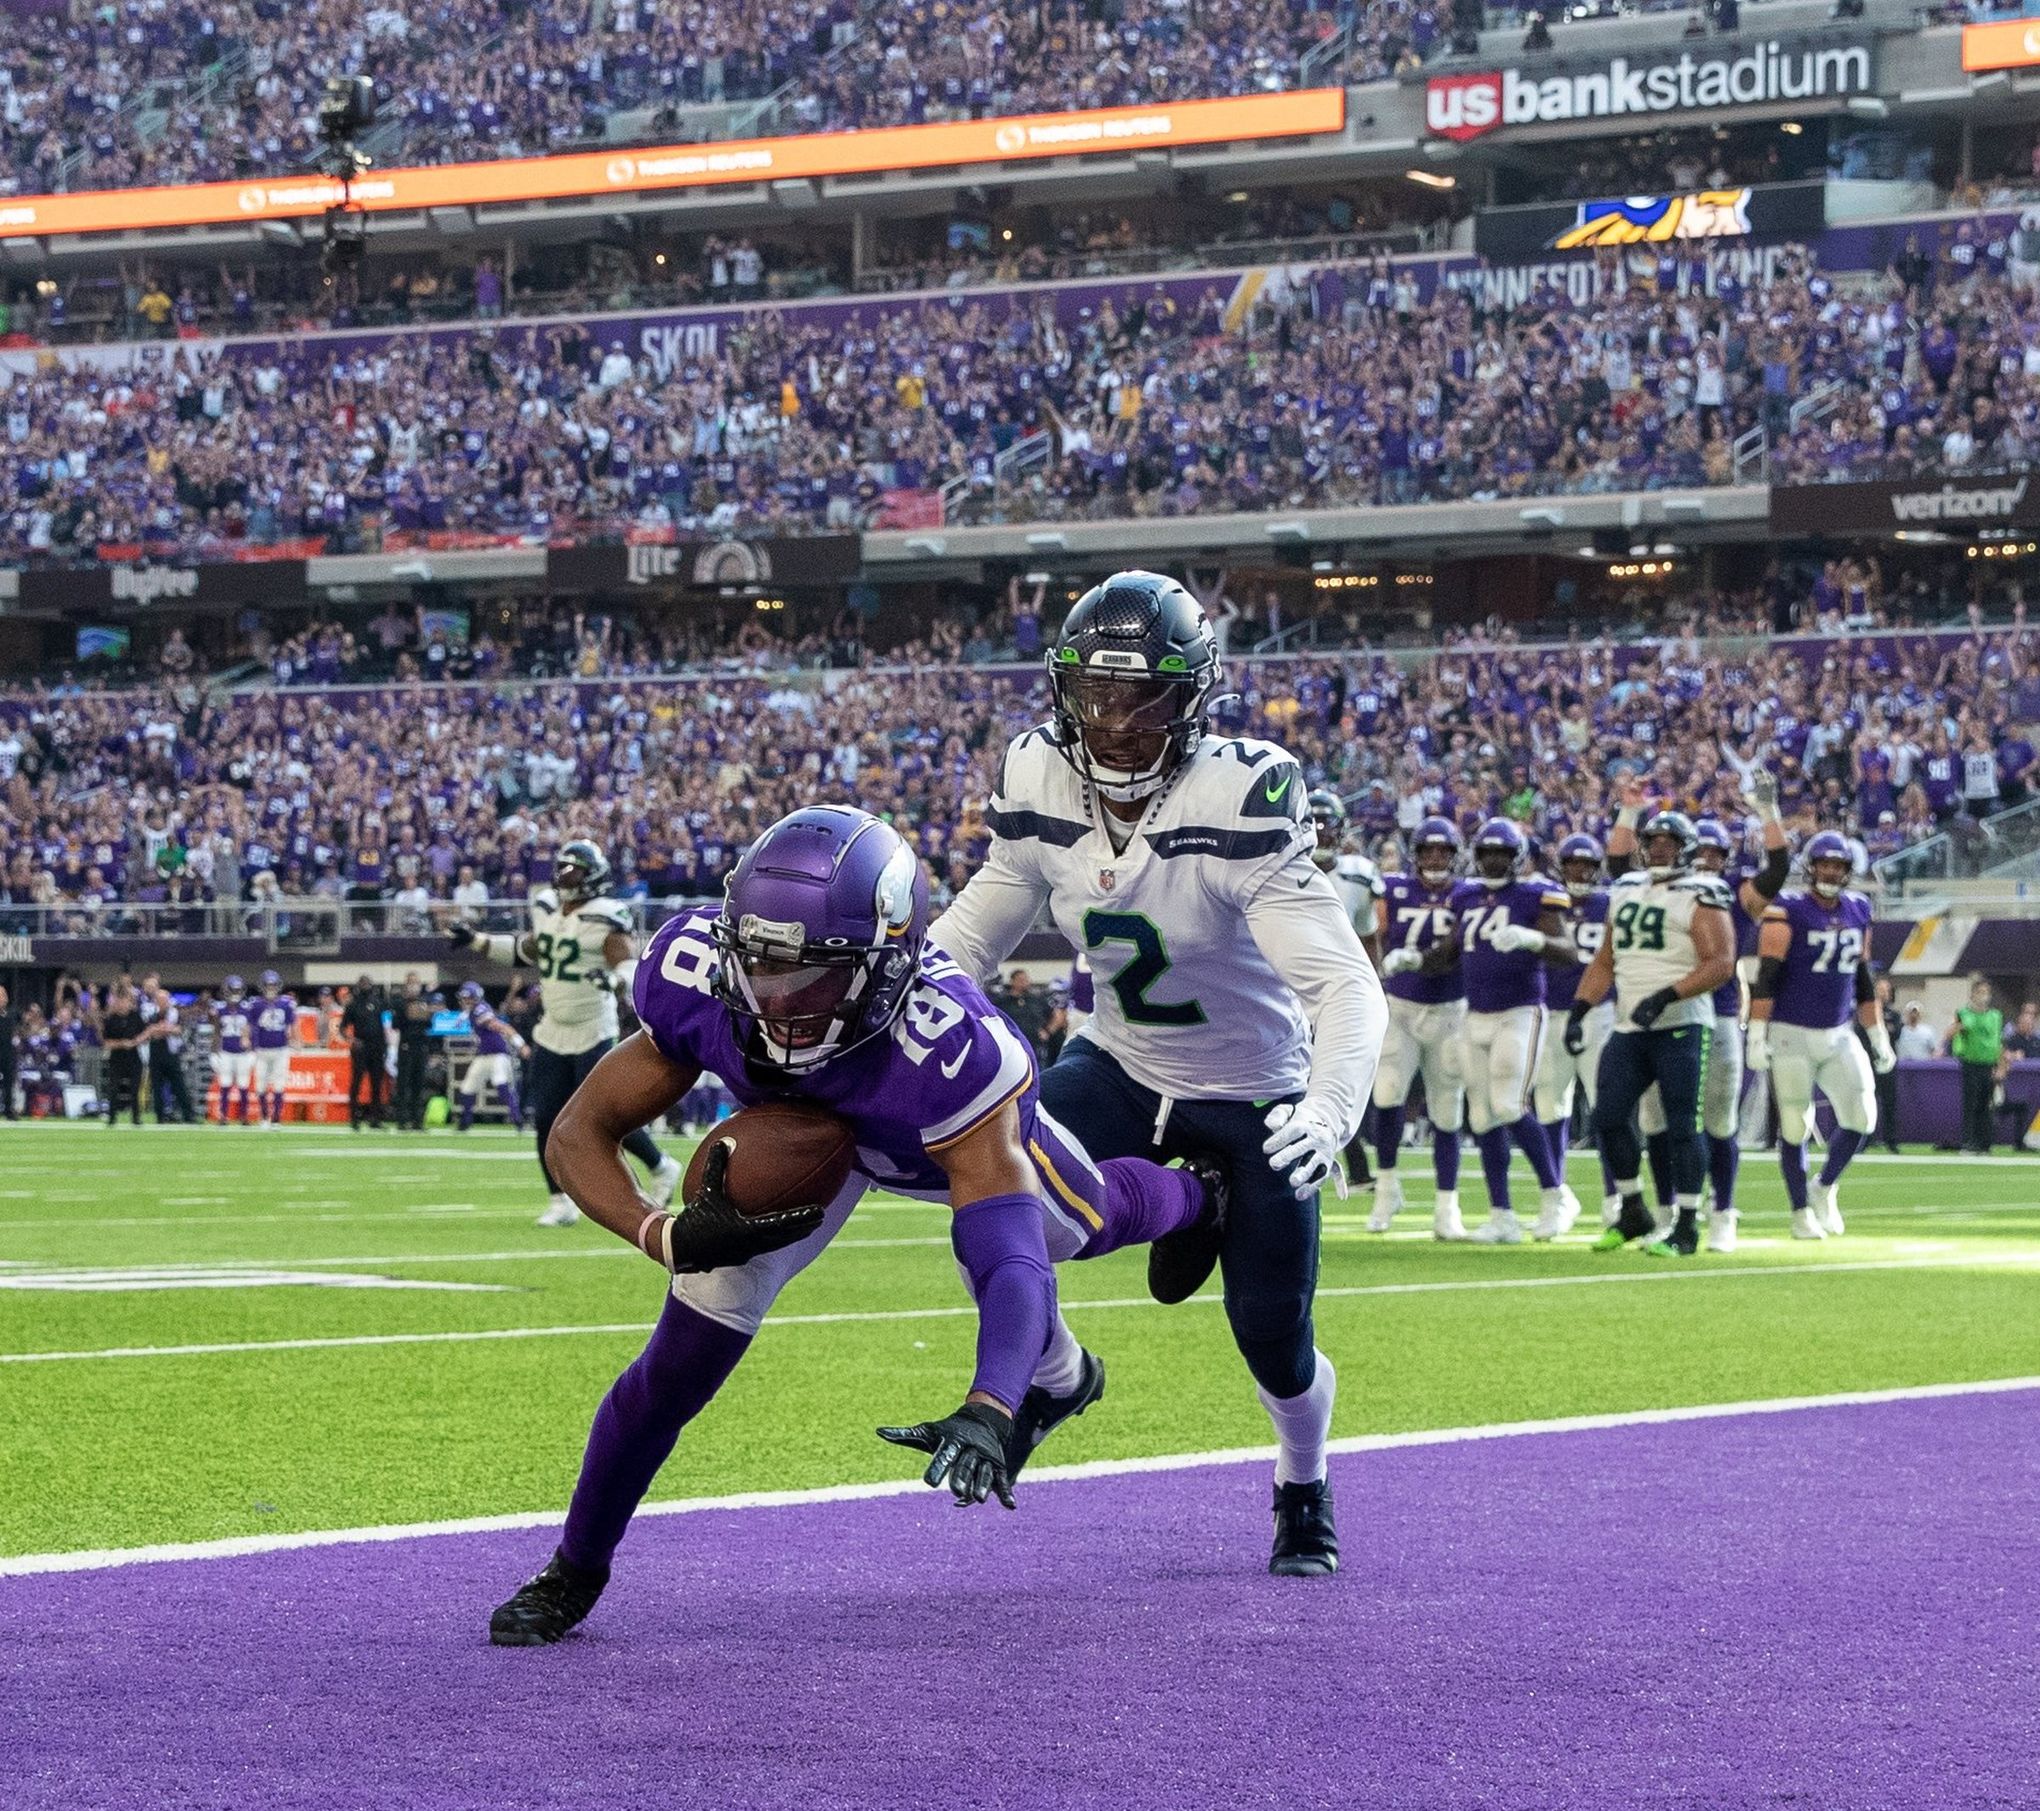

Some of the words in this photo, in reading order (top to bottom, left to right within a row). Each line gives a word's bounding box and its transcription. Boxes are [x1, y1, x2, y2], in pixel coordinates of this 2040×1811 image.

[1168, 837, 1218, 849] SEAHAWKS
[1614, 902, 1665, 951] 99
[1806, 927, 1864, 974] 72
[1080, 907, 1209, 1027] 2
